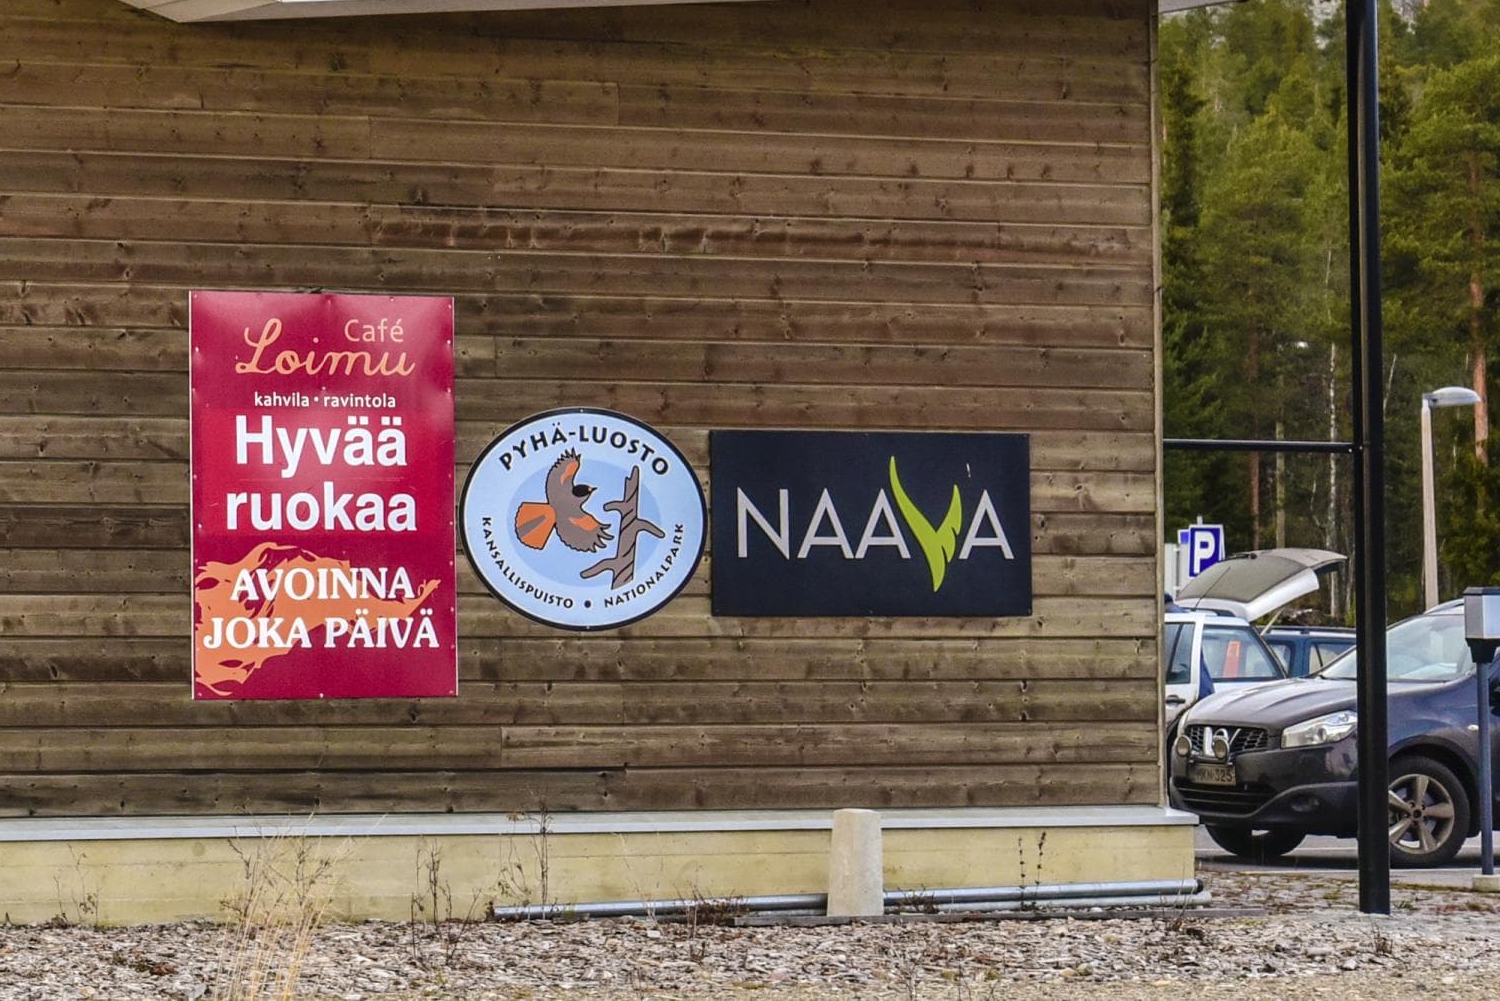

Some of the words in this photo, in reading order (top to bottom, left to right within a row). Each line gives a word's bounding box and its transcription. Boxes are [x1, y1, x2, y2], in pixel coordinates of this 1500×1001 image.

[235, 317, 416, 377] Loimu
[344, 318, 404, 343] Café
[254, 391, 310, 407] kahvila
[323, 393, 396, 408] ravintola
[235, 414, 407, 478] Hyvää
[498, 422, 669, 475] PYHÄ-LUOSTO
[226, 481, 417, 531] ruokaa
[736, 455, 1015, 592] NAAVA
[482, 516, 574, 609] KANSALLISPUISTO
[604, 523, 684, 609] NATIONALPARK
[1193, 531, 1216, 574] P
[229, 567, 417, 601] AVOINNA
[203, 617, 312, 649] JOKA
[324, 608, 440, 648] PÄIVÄ
